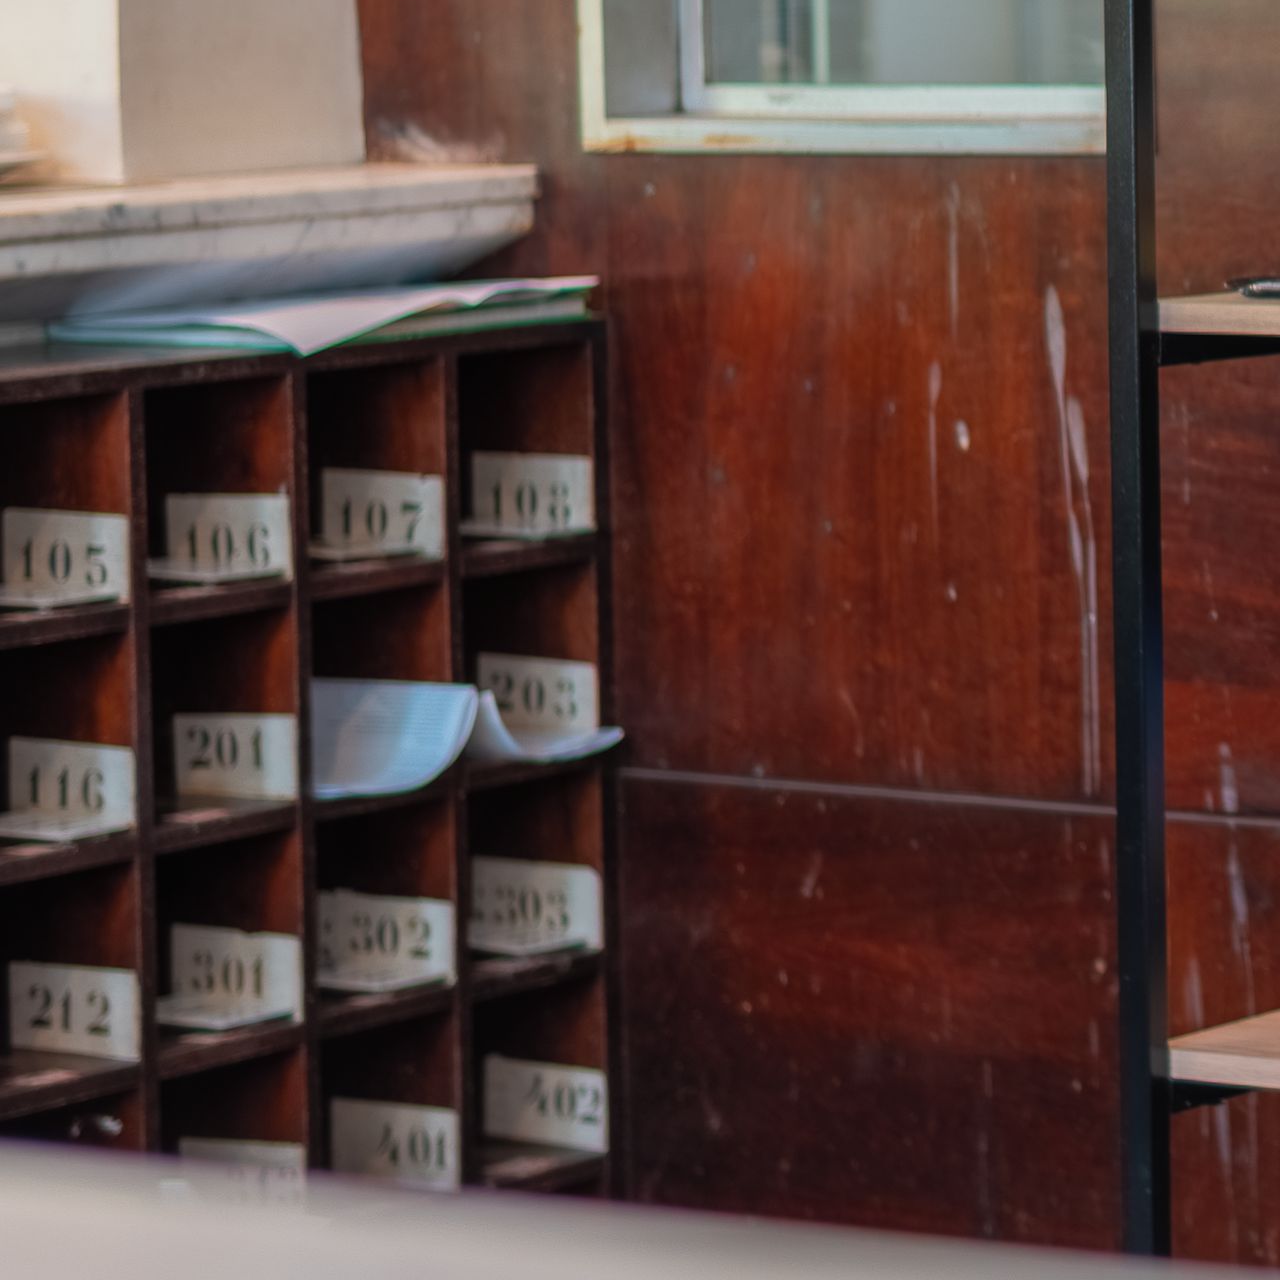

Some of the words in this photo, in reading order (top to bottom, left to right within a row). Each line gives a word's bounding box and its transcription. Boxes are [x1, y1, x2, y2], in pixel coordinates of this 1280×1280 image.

[340, 498, 424, 543] 107
[492, 478, 573, 523] 108
[21, 538, 109, 590] 105
[184, 523, 271, 570] 106
[490, 671, 579, 717] 203
[186, 726, 266, 771] 201
[27, 765, 106, 813] 116
[191, 951, 265, 998] 301
[28, 983, 111, 1035] 212
[528, 1076, 601, 1123] 402
[379, 1125, 447, 1172] 401
